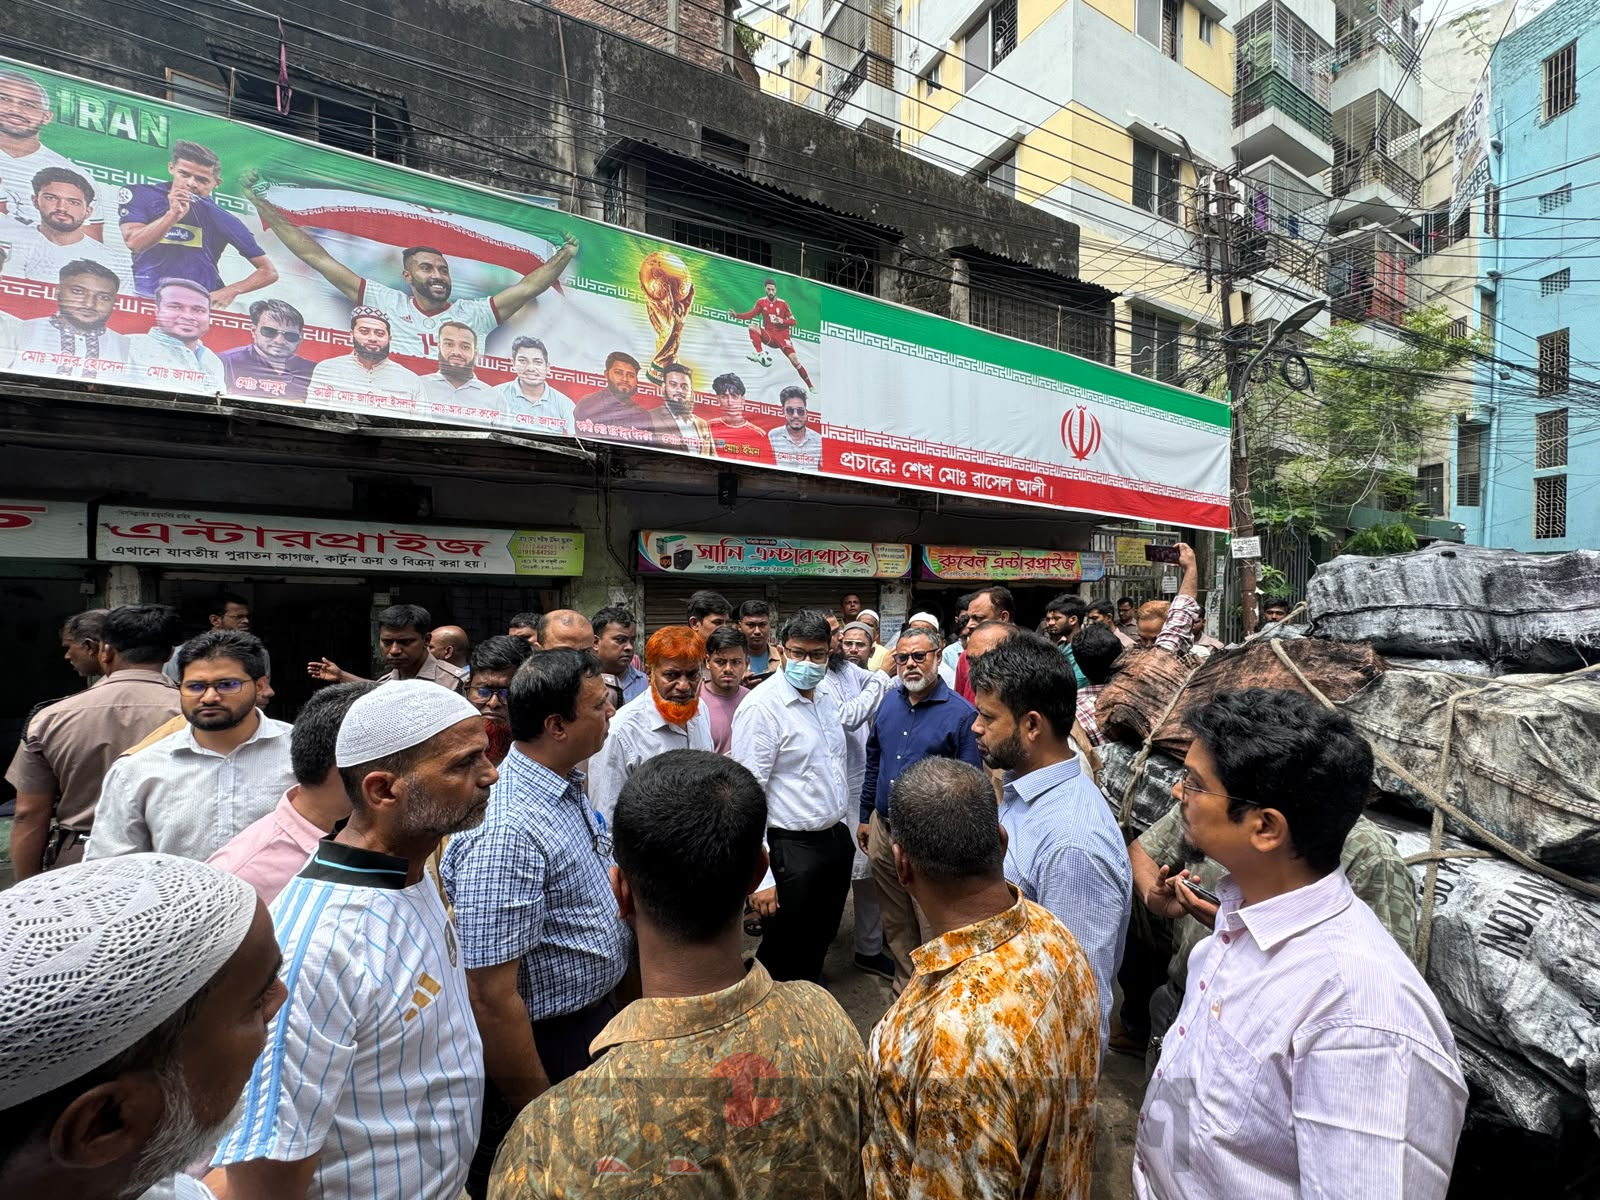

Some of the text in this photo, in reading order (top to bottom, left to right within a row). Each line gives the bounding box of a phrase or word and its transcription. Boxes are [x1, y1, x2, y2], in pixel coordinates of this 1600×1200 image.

[57, 89, 169, 149] IRAN
[21, 350, 46, 364] মোঃ
[84, 357, 126, 373] হোসেন
[147, 365, 206, 384] মোঃ জামান
[515, 413, 567, 429] মোঃ জামান
[724, 443, 740, 455] মোঃ
[902, 461, 934, 481] শেখ
[939, 467, 967, 486] মোঃ
[971, 471, 1013, 493] রাসেল
[1016, 477, 1047, 498] আলী
[109, 517, 491, 558] এন্টারপ্রাইজ
[112, 546, 161, 557] এখানে
[166, 547, 219, 560] যাবতীয়
[225, 550, 272, 562] পুরাতন
[276, 552, 320, 564] কাগজ,
[324, 553, 356, 567] কার্টুন
[361, 556, 384, 566] ক্রয়
[403, 555, 435, 568] বিক্রয়
[439, 559, 460, 569] করা
[464, 560, 480, 569] হয়
[694, 536, 746, 566] সানি
[749, 540, 873, 569] এন্টারপ্রাইজ
[937, 555, 988, 571] রুবেল
[991, 551, 1077, 573] এন্টারপ্রাইজ
[1478, 874, 1558, 961] INDIAN
